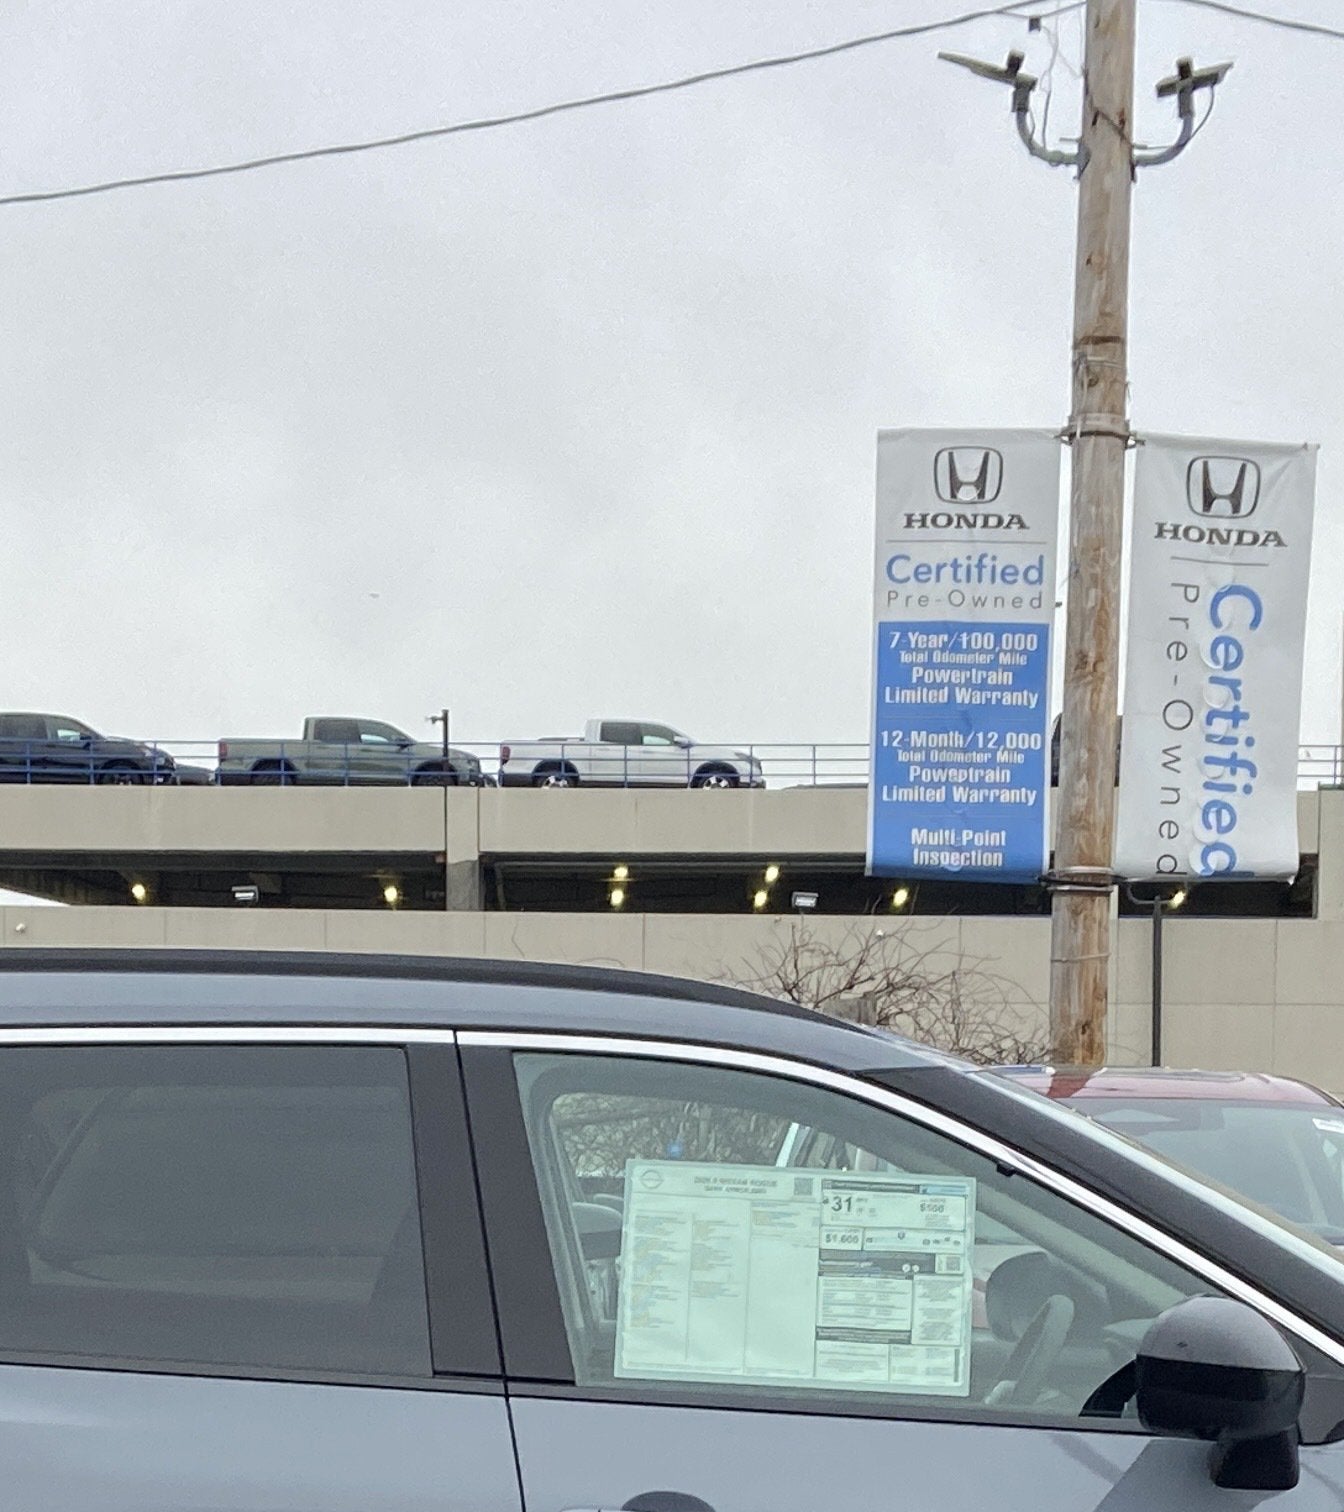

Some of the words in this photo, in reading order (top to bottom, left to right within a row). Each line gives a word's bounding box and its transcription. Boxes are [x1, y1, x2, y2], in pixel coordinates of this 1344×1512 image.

[903, 512, 1030, 530] HONDA
[1154, 521, 1288, 548] HONDA
[885, 552, 1045, 586] Certified
[886, 588, 1044, 610] Pre-Owned
[888, 630, 1039, 653] 7-Year/100,000
[899, 650, 929, 664] Total
[932, 650, 995, 665] Odometer
[998, 652, 1028, 666] Mile
[911, 666, 1014, 686] Powertrain
[884, 686, 949, 704] Limited
[954, 687, 1039, 709] Warranty
[881, 730, 1042, 752] 12-Month/12,000
[1156, 582, 1201, 878] Pre-Owned
[1200, 583, 1264, 880] Certified
[897, 749, 926, 763] Total
[929, 749, 992, 764] Odometer
[996, 750, 1025, 765] Mile
[881, 785, 947, 803] Limited
[952, 785, 1038, 807] Warranty
[910, 828, 1007, 847] Multi-Point
[912, 848, 1004, 870] Inspection
[831, 1195, 853, 1213] 31
